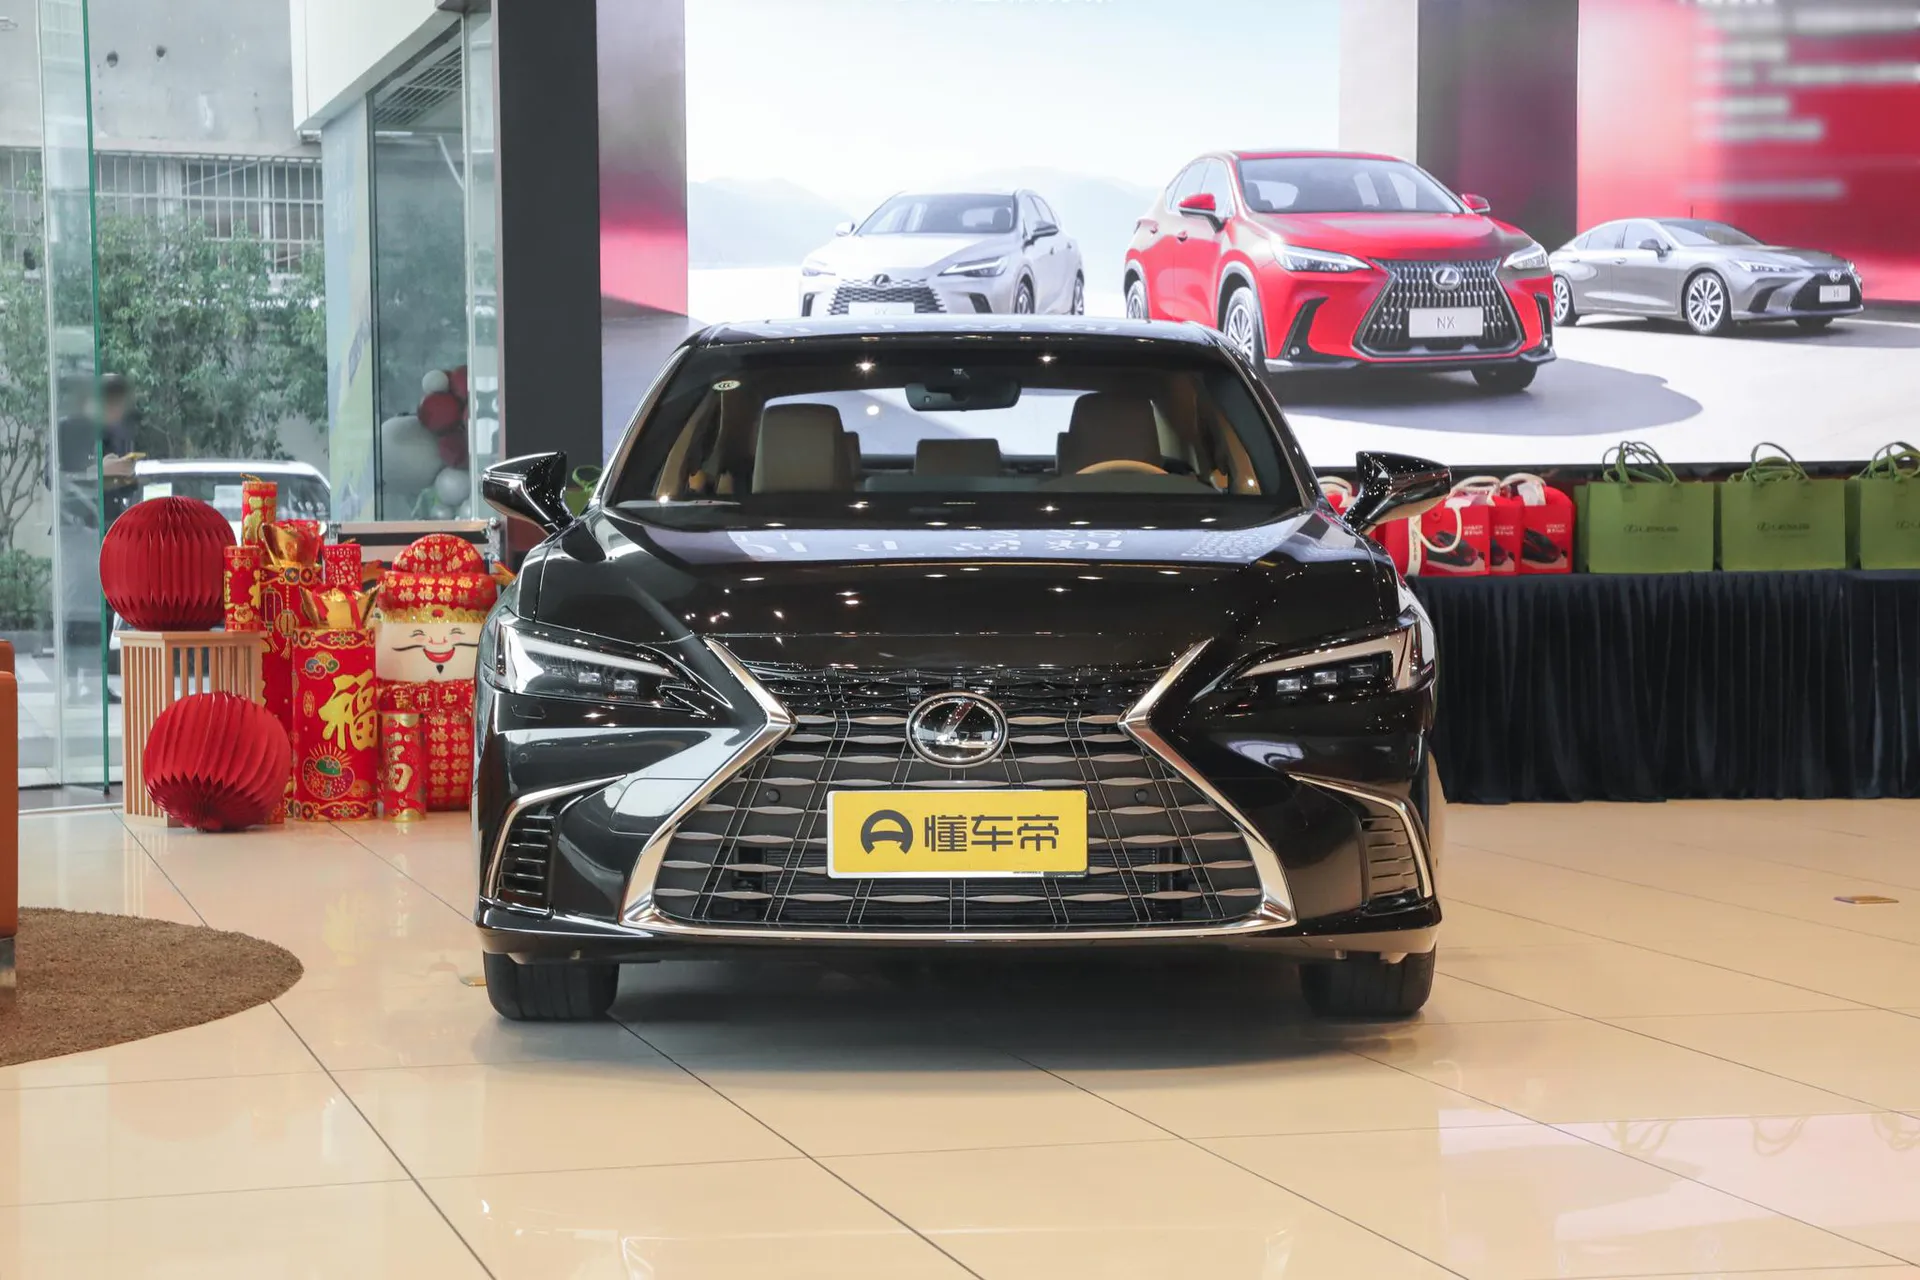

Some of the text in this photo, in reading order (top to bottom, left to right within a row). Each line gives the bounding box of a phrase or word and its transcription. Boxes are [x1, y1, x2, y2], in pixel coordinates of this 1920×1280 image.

[1436, 316, 1455, 329] NX
[318, 669, 379, 751] 福
[924, 814, 1060, 852] 懂车帝
